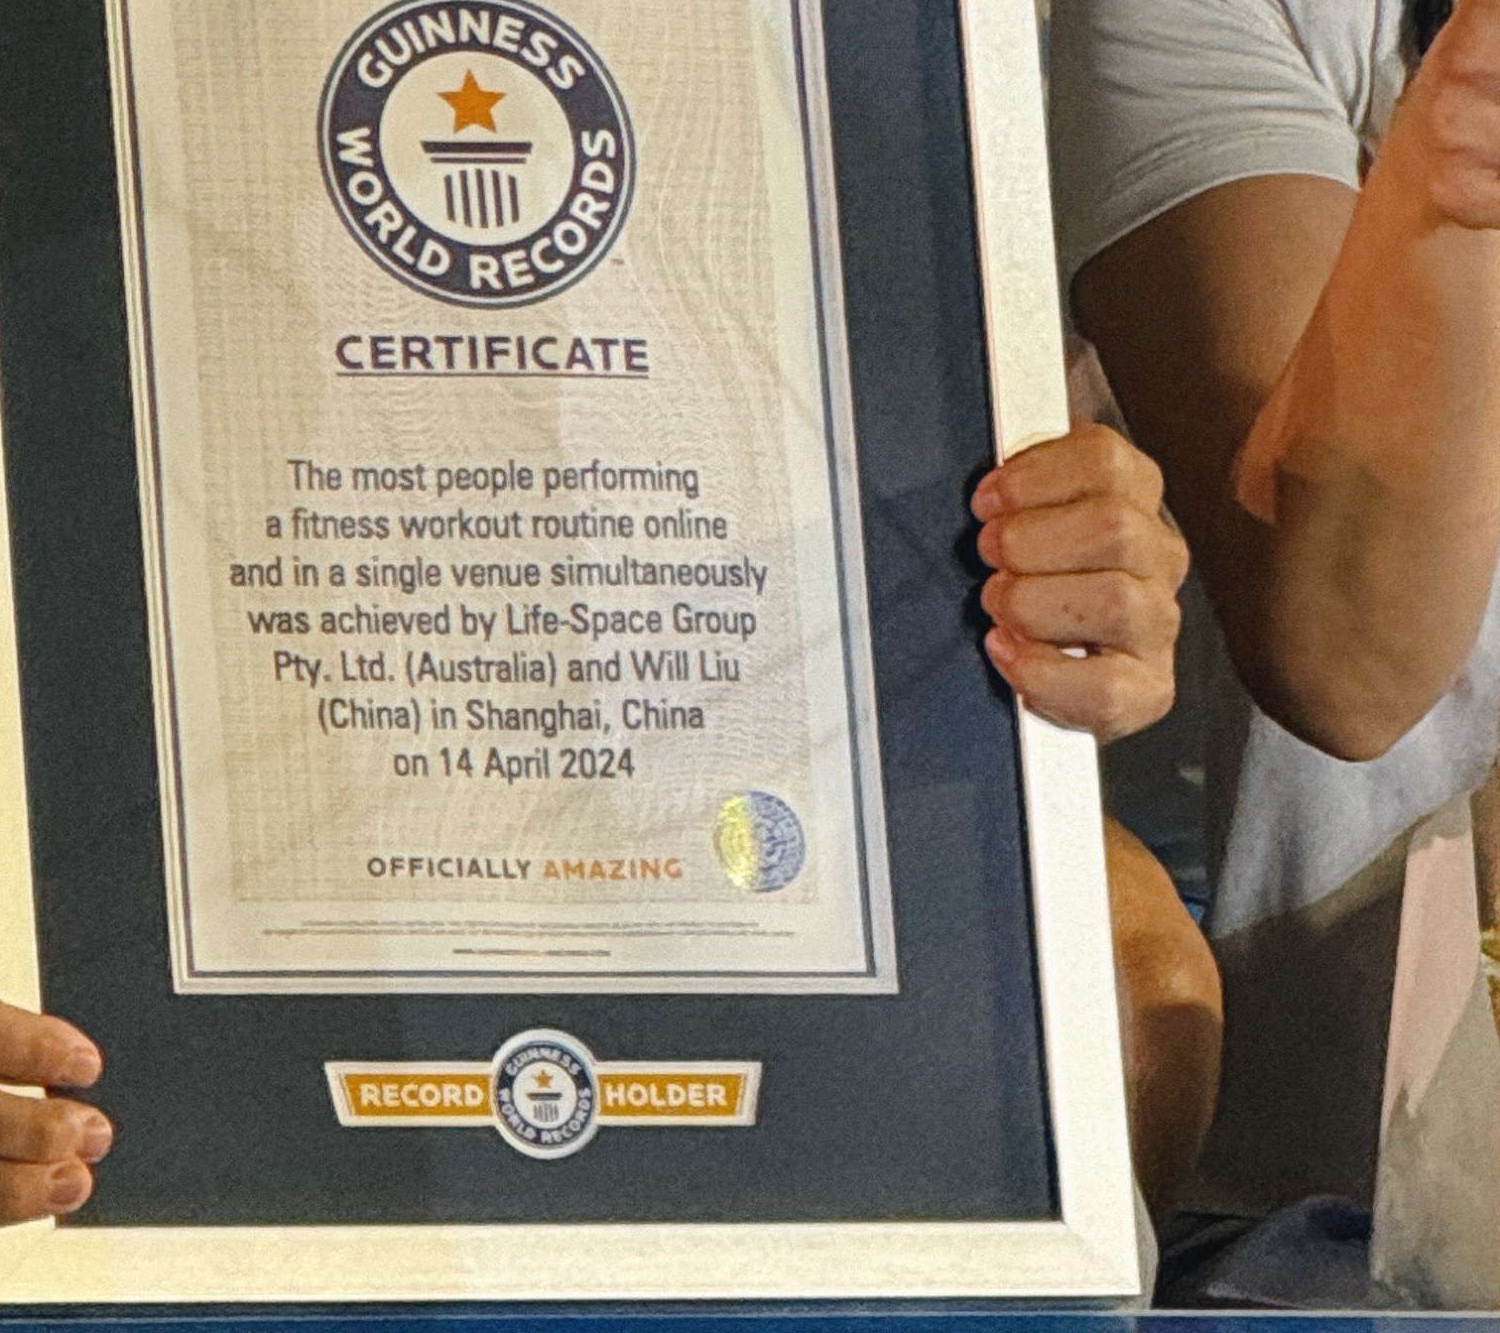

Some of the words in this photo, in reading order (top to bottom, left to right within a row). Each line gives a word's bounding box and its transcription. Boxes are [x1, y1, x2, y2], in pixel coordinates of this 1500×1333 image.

[356, 8, 587, 91] GUINNESS
[336, 126, 452, 277] WORLD
[468, 129, 617, 291] RECORDS
[335, 334, 651, 374] CERTIFICATE
[286, 458, 342, 491] The
[352, 461, 426, 491] most
[436, 459, 533, 497] people
[543, 459, 700, 500] performing
[265, 515, 282, 539] a
[291, 506, 390, 540] fitness
[399, 509, 522, 539] workout
[531, 508, 634, 539] routine
[643, 508, 728, 540] online
[229, 556, 283, 587] and
[293, 557, 319, 587] in
[329, 564, 346, 587] a
[356, 556, 441, 595] single
[451, 563, 541, 588] venue
[550, 555, 768, 595] simultaneously
[247, 611, 311, 635] was
[320, 604, 451, 635] achieved
[460, 604, 497, 641] by
[506, 602, 662, 640] Life-Space
[672, 602, 757, 642] Group
[273, 650, 331, 688] Pty.
[340, 651, 394, 682] Ltd.
[405, 651, 557, 687] (Australia)
[567, 651, 621, 683] and
[630, 650, 689, 681] Will
[699, 651, 741, 683] Liu
[317, 697, 421, 734] (China)
[432, 700, 457, 729] in
[466, 699, 610, 739] Shanghai,
[622, 698, 705, 731] China
[393, 753, 429, 777] on
[440, 747, 473, 777] 14
[484, 747, 550, 785] April
[560, 747, 635, 779] 2024
[366, 856, 531, 879] OFFICIALLY
[542, 858, 684, 880] AMAZING
[359, 1082, 485, 1109] RECORD
[605, 1083, 729, 1108] HOLDER
